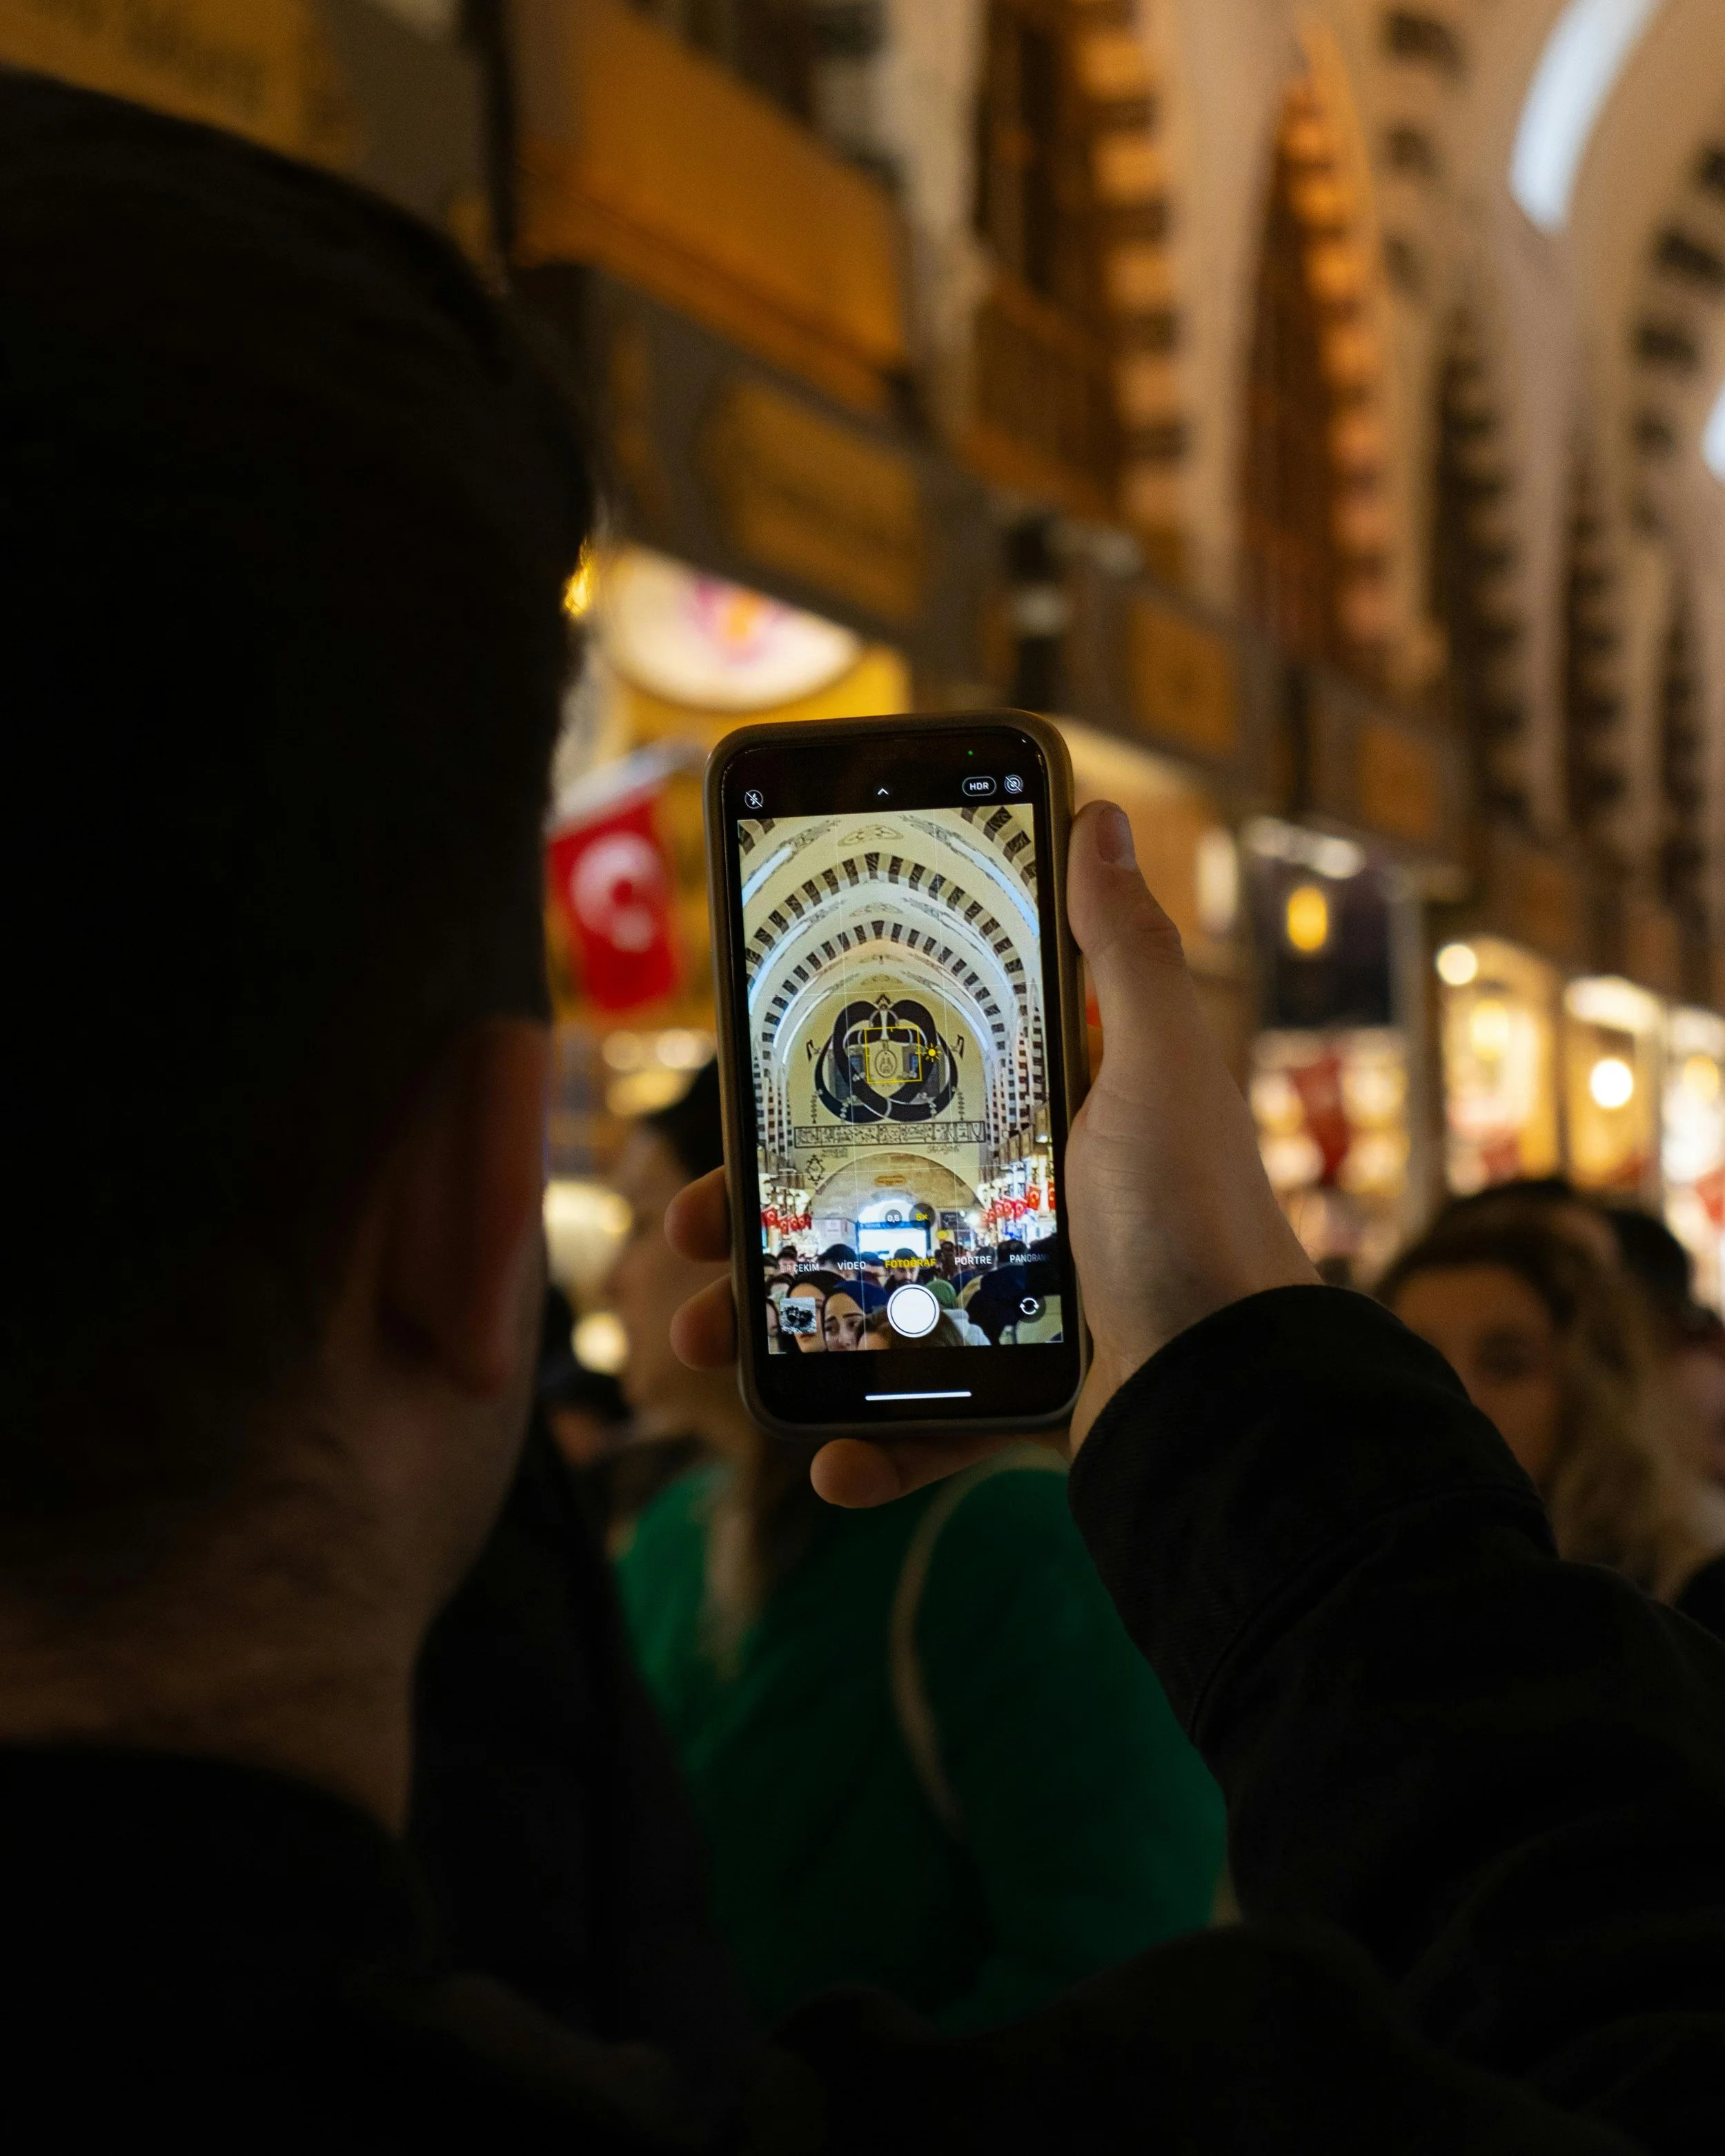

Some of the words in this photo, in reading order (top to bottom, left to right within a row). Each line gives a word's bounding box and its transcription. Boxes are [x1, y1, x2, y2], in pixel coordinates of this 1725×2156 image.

[969, 782, 989, 791] HDR
[887, 1214, 900, 1223] 0,5
[793, 1260, 820, 1274] ÇEKİM
[837, 1259, 867, 1270] VİDEO
[885, 1256, 936, 1269] FOTOĞRAF
[954, 1255, 992, 1265] PORTRE
